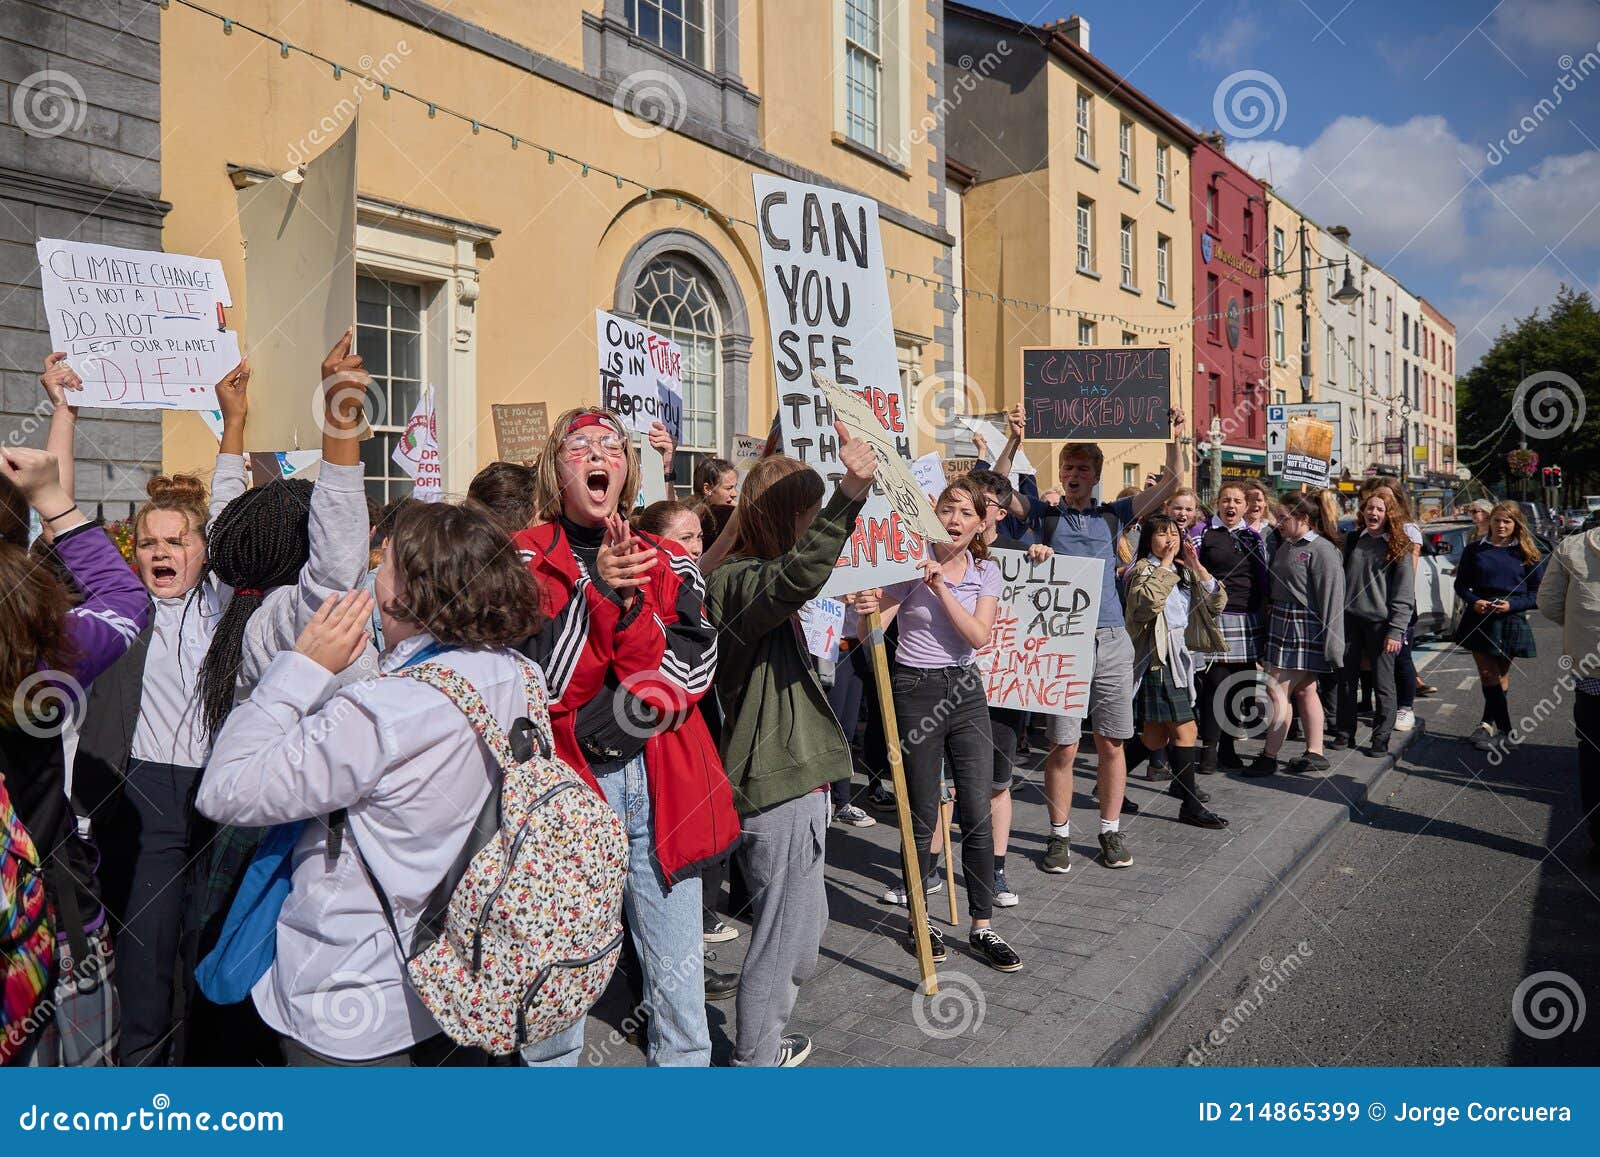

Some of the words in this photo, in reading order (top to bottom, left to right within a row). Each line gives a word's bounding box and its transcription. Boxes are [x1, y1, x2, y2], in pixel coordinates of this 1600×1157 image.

[760, 191, 868, 269] CAN
[49, 250, 146, 284] CLIMATE
[150, 262, 214, 290] CHANGE
[69, 286, 89, 305] IS
[96, 287, 132, 304] NOT
[134, 286, 145, 302] A
[774, 264, 850, 328] YOU
[57, 308, 97, 342] DO
[104, 312, 157, 337] NOT
[72, 339, 123, 356] LET
[130, 338, 162, 353] OUR
[168, 338, 217, 353] PLANET
[606, 319, 647, 354] OUR
[647, 335, 682, 382] FUTURE
[777, 329, 859, 389] SEE
[607, 351, 624, 376] IS
[629, 355, 645, 377] IN
[1040, 351, 1163, 384] CAPITAL
[1080, 384, 1108, 396] HAS
[1033, 397, 1124, 435] FUCKED
[1129, 395, 1162, 425] UP
[1287, 460, 1297, 468] NOT
[1298, 462, 1308, 470] THE
[1308, 464, 1327, 474] CLIMATE
[836, 511, 923, 568] AMES
[816, 598, 842, 618] EANS
[1002, 585, 1026, 604] OF
[1032, 586, 1091, 614] OLD
[1026, 612, 1085, 638] AGE
[1023, 637, 1050, 652] OF
[986, 675, 1090, 710] HANGE
